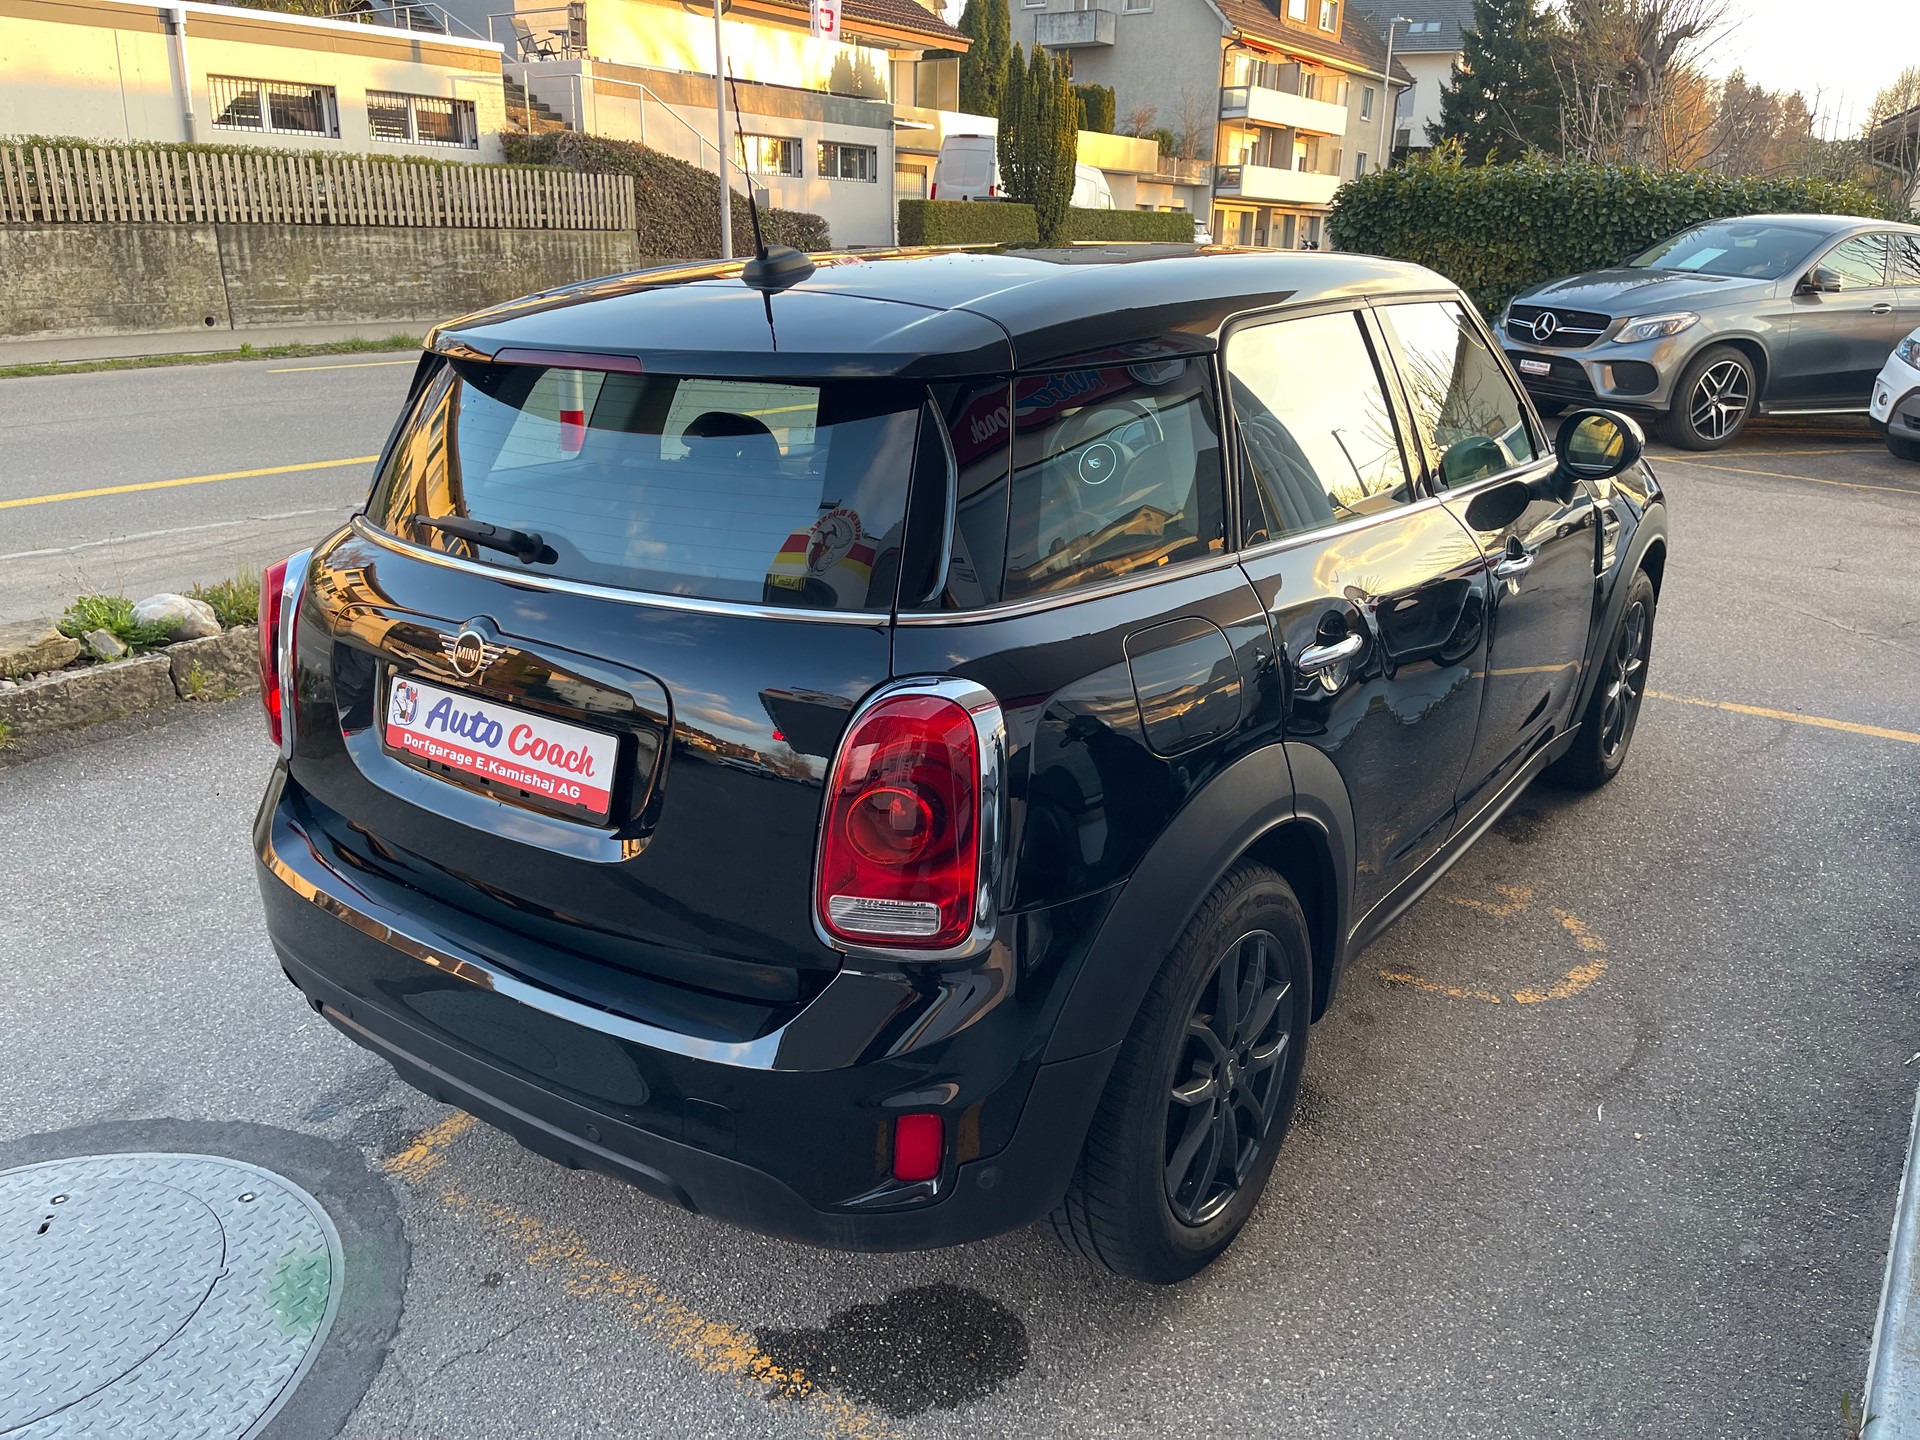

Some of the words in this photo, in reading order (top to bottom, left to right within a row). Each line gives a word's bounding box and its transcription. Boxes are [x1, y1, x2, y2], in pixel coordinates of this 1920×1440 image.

[456, 645, 479, 662] MINI
[404, 733, 473, 766] Dorfgarage
[475, 757, 556, 794] E.Kamishaj
[557, 783, 581, 799] AG
[425, 697, 503, 748] Auto
[508, 724, 595, 777] Coach
